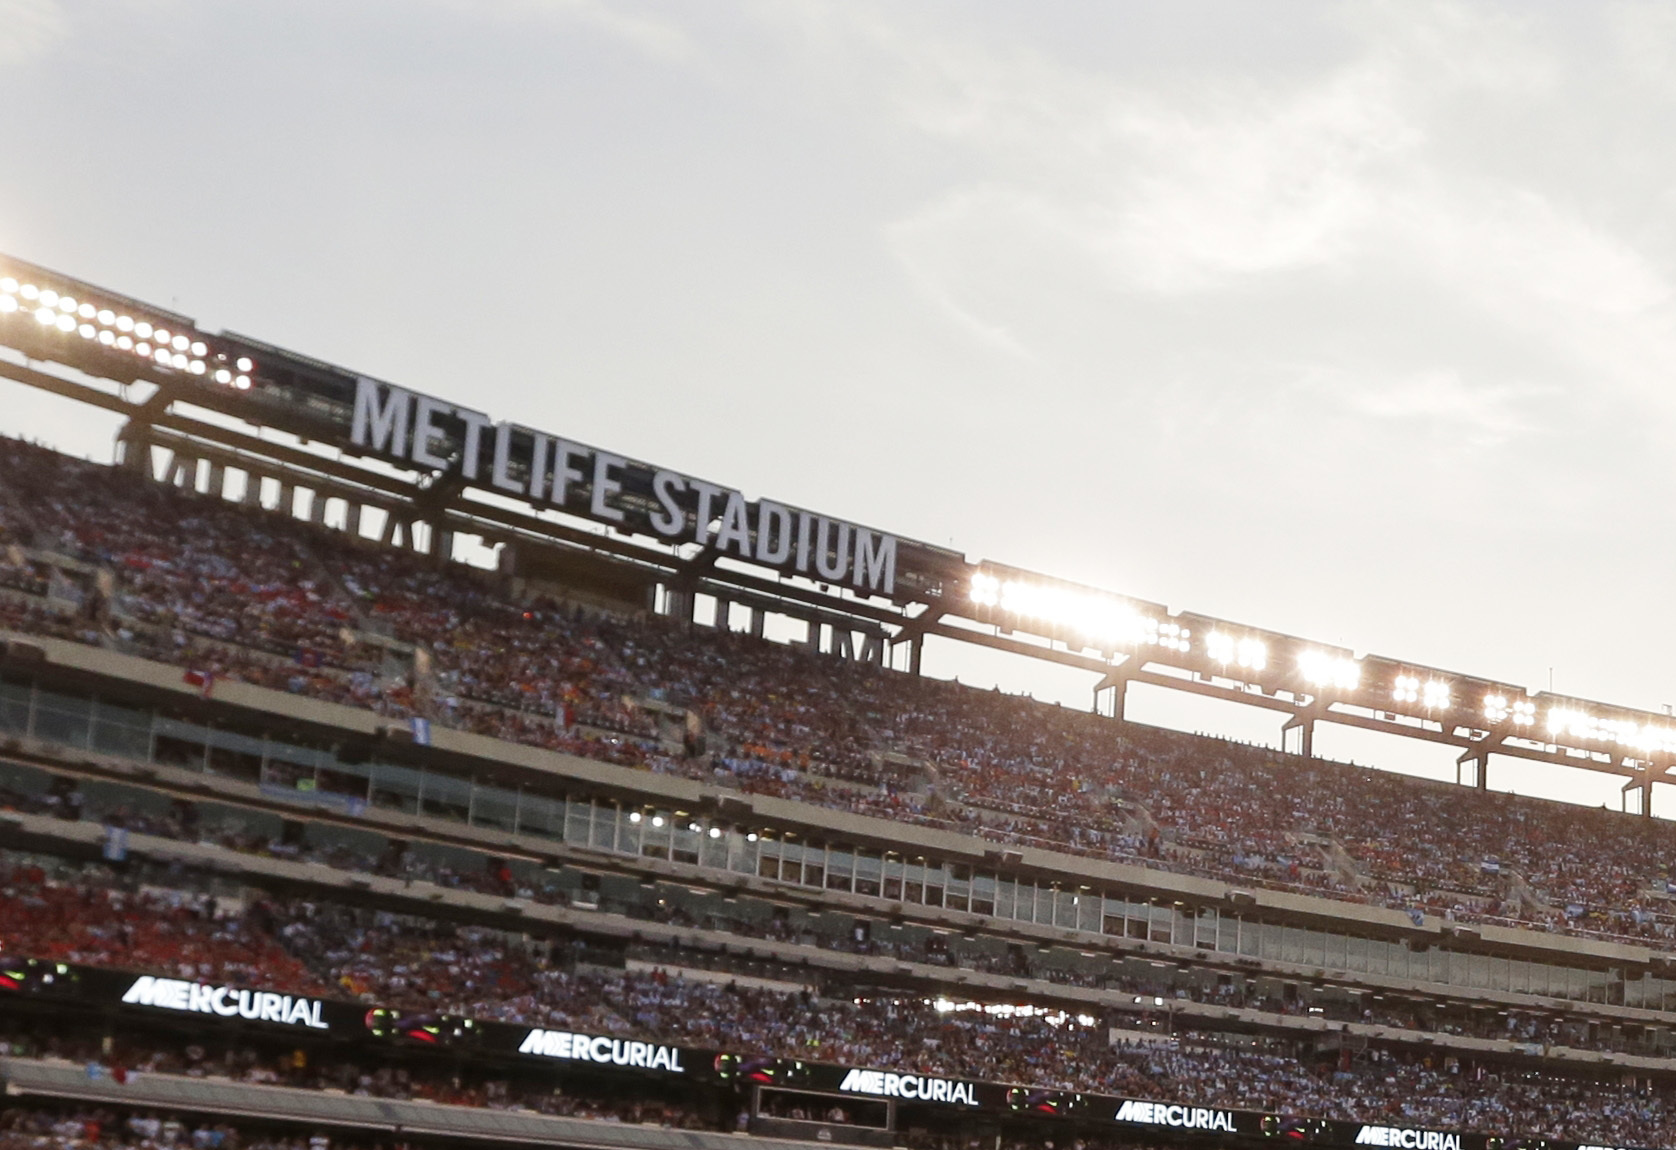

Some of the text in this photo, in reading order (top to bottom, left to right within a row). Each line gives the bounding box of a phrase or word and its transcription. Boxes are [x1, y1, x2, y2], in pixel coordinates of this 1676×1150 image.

[350, 376, 897, 594] METLIFE STADIUM
[122, 976, 329, 1028] MERCURIAL
[519, 1028, 684, 1072] MERCURIAL
[839, 1068, 979, 1105] MERCURIAL
[1115, 1100, 1237, 1132] MERCURIAL
